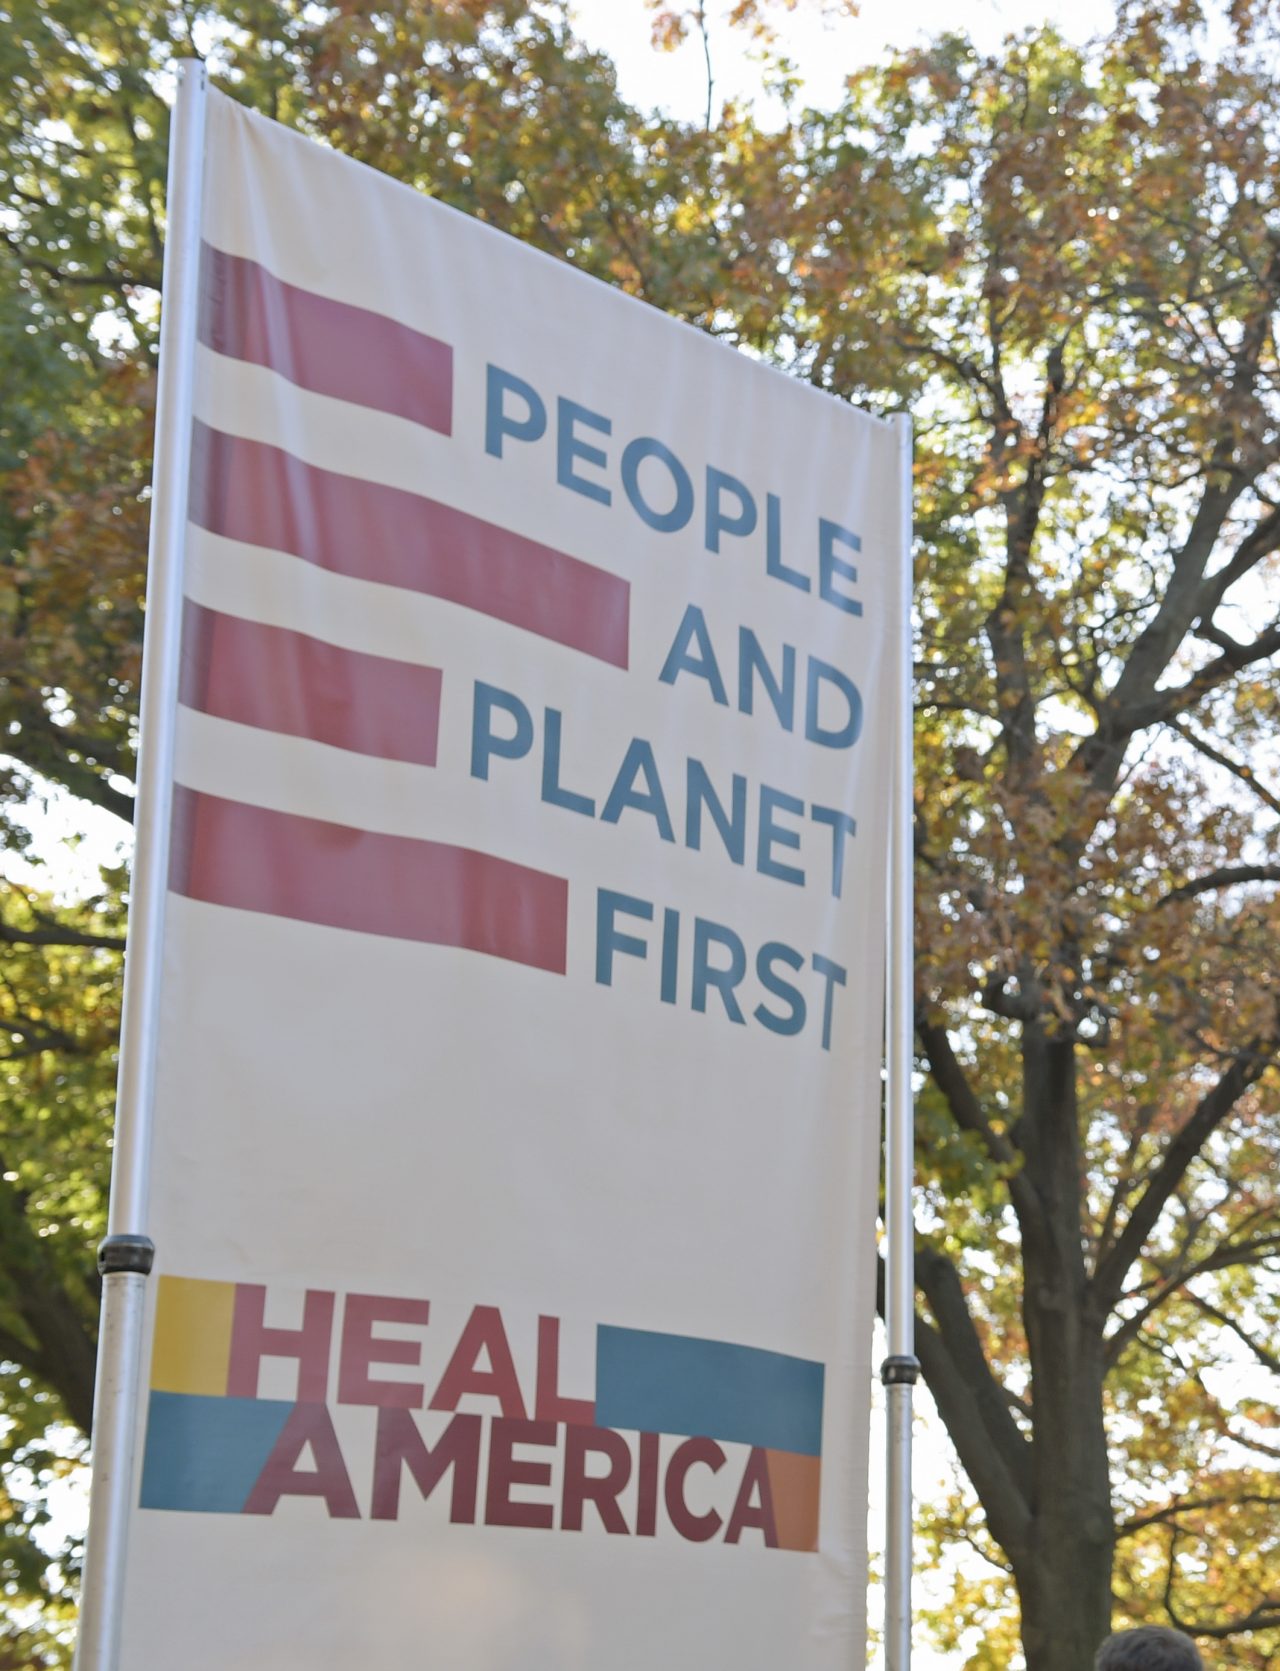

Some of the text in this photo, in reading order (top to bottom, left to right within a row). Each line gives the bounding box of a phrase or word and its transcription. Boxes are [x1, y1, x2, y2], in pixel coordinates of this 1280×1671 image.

[485, 363, 863, 618] PEOPLE
[658, 603, 864, 750] AND
[470, 679, 857, 899] PLANET
[595, 886, 847, 1052] FIRST
[225, 1282, 597, 1427] HEAL
[240, 1400, 780, 1549] AMERICA
